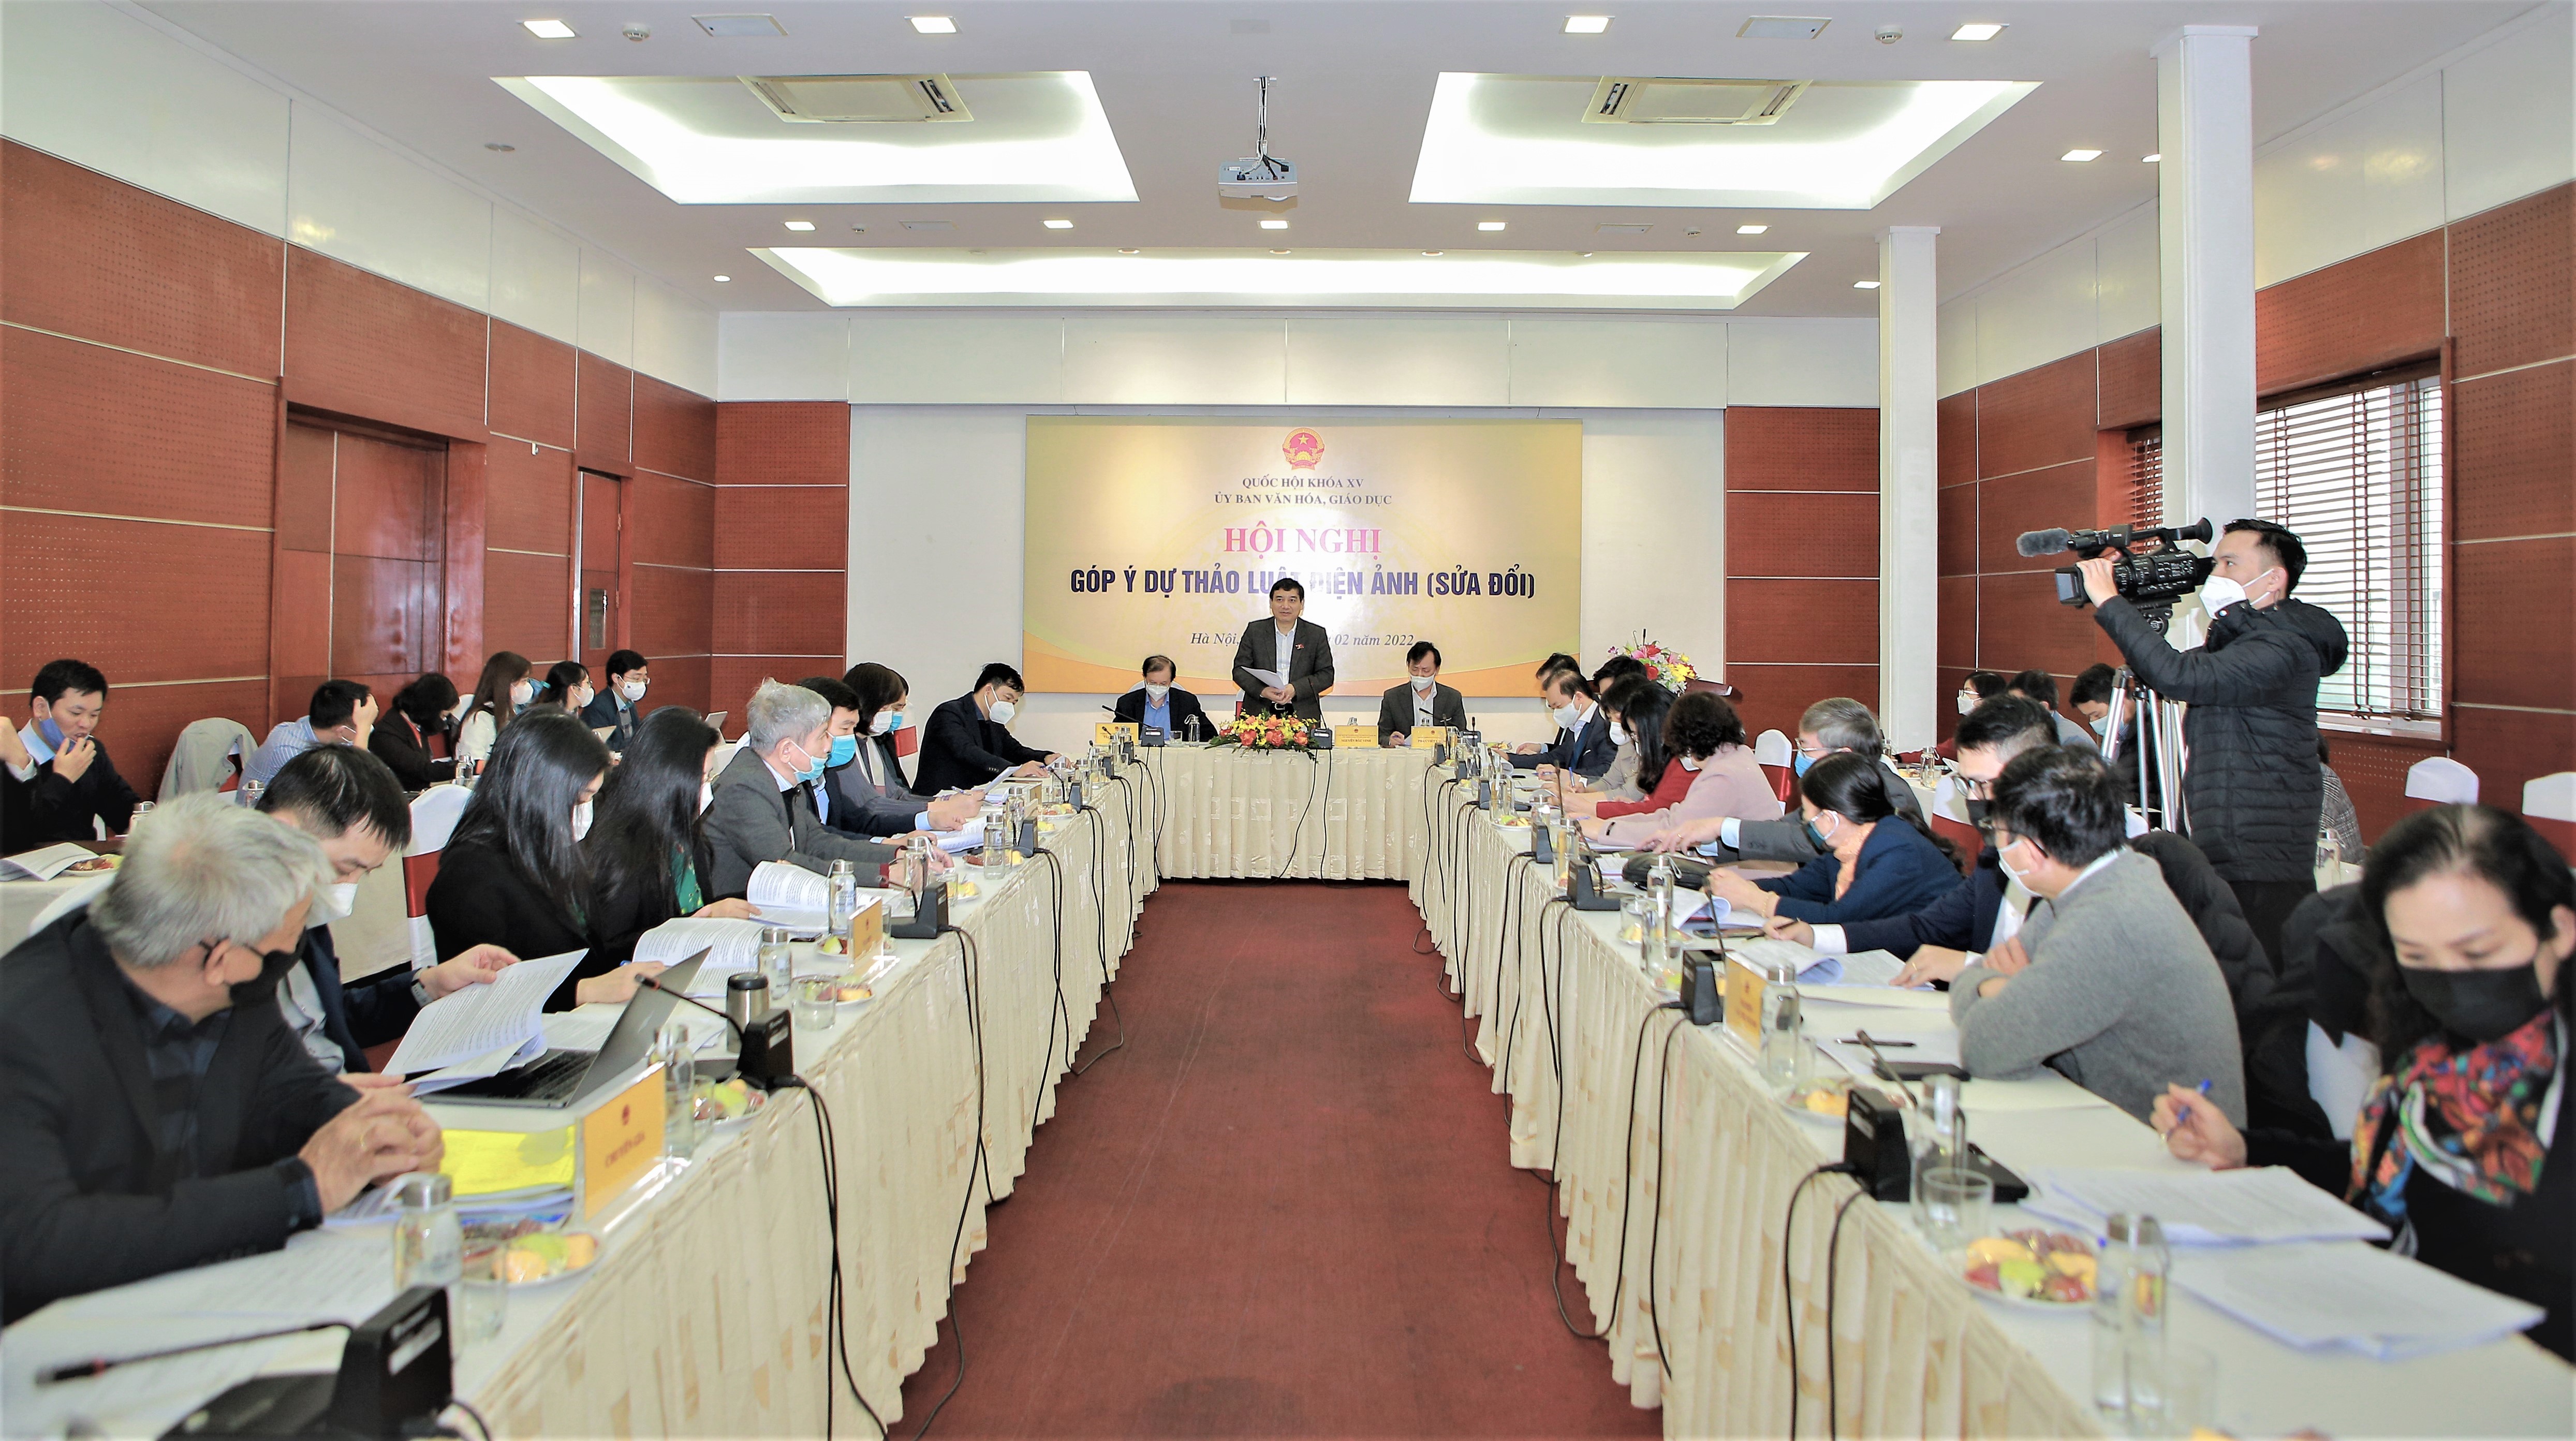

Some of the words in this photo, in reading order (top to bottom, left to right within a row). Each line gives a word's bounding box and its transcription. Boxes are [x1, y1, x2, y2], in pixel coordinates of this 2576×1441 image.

[1242, 474, 1278, 489] QUỐC
[1282, 476, 1304, 490] HỘI
[1308, 476, 1343, 488] KHÓA
[1347, 479, 1364, 488] XV
[1215, 492, 1232, 504] ỦY
[1235, 494, 1261, 504] BAN
[1265, 492, 1292, 504] VĂN
[1295, 493, 1326, 506] HÓA,
[1329, 493, 1362, 504] GIÁO
[1365, 495, 1392, 507] DỤC
[1224, 521, 1286, 560] HỘI
[1295, 528, 1382, 560] NGHỊ
[1070, 565, 1115, 593] GÓP
[1123, 565, 1137, 593] Ý
[1144, 568, 1177, 598] DỰ
[1182, 562, 1240, 594] THẢO
[1309, 567, 1363, 599] ĐIỆN
[1371, 564, 1418, 595] ẢNH
[1427, 564, 1481, 598] (SỬA
[1488, 564, 1535, 598] ĐỔI)
[1190, 633, 1210, 644] Hà
[1213, 633, 1239, 646] Nội,
[1334, 634, 1349, 645] 02
[1353, 635, 1380, 645] năm
[1384, 635, 1414, 645] 2022
